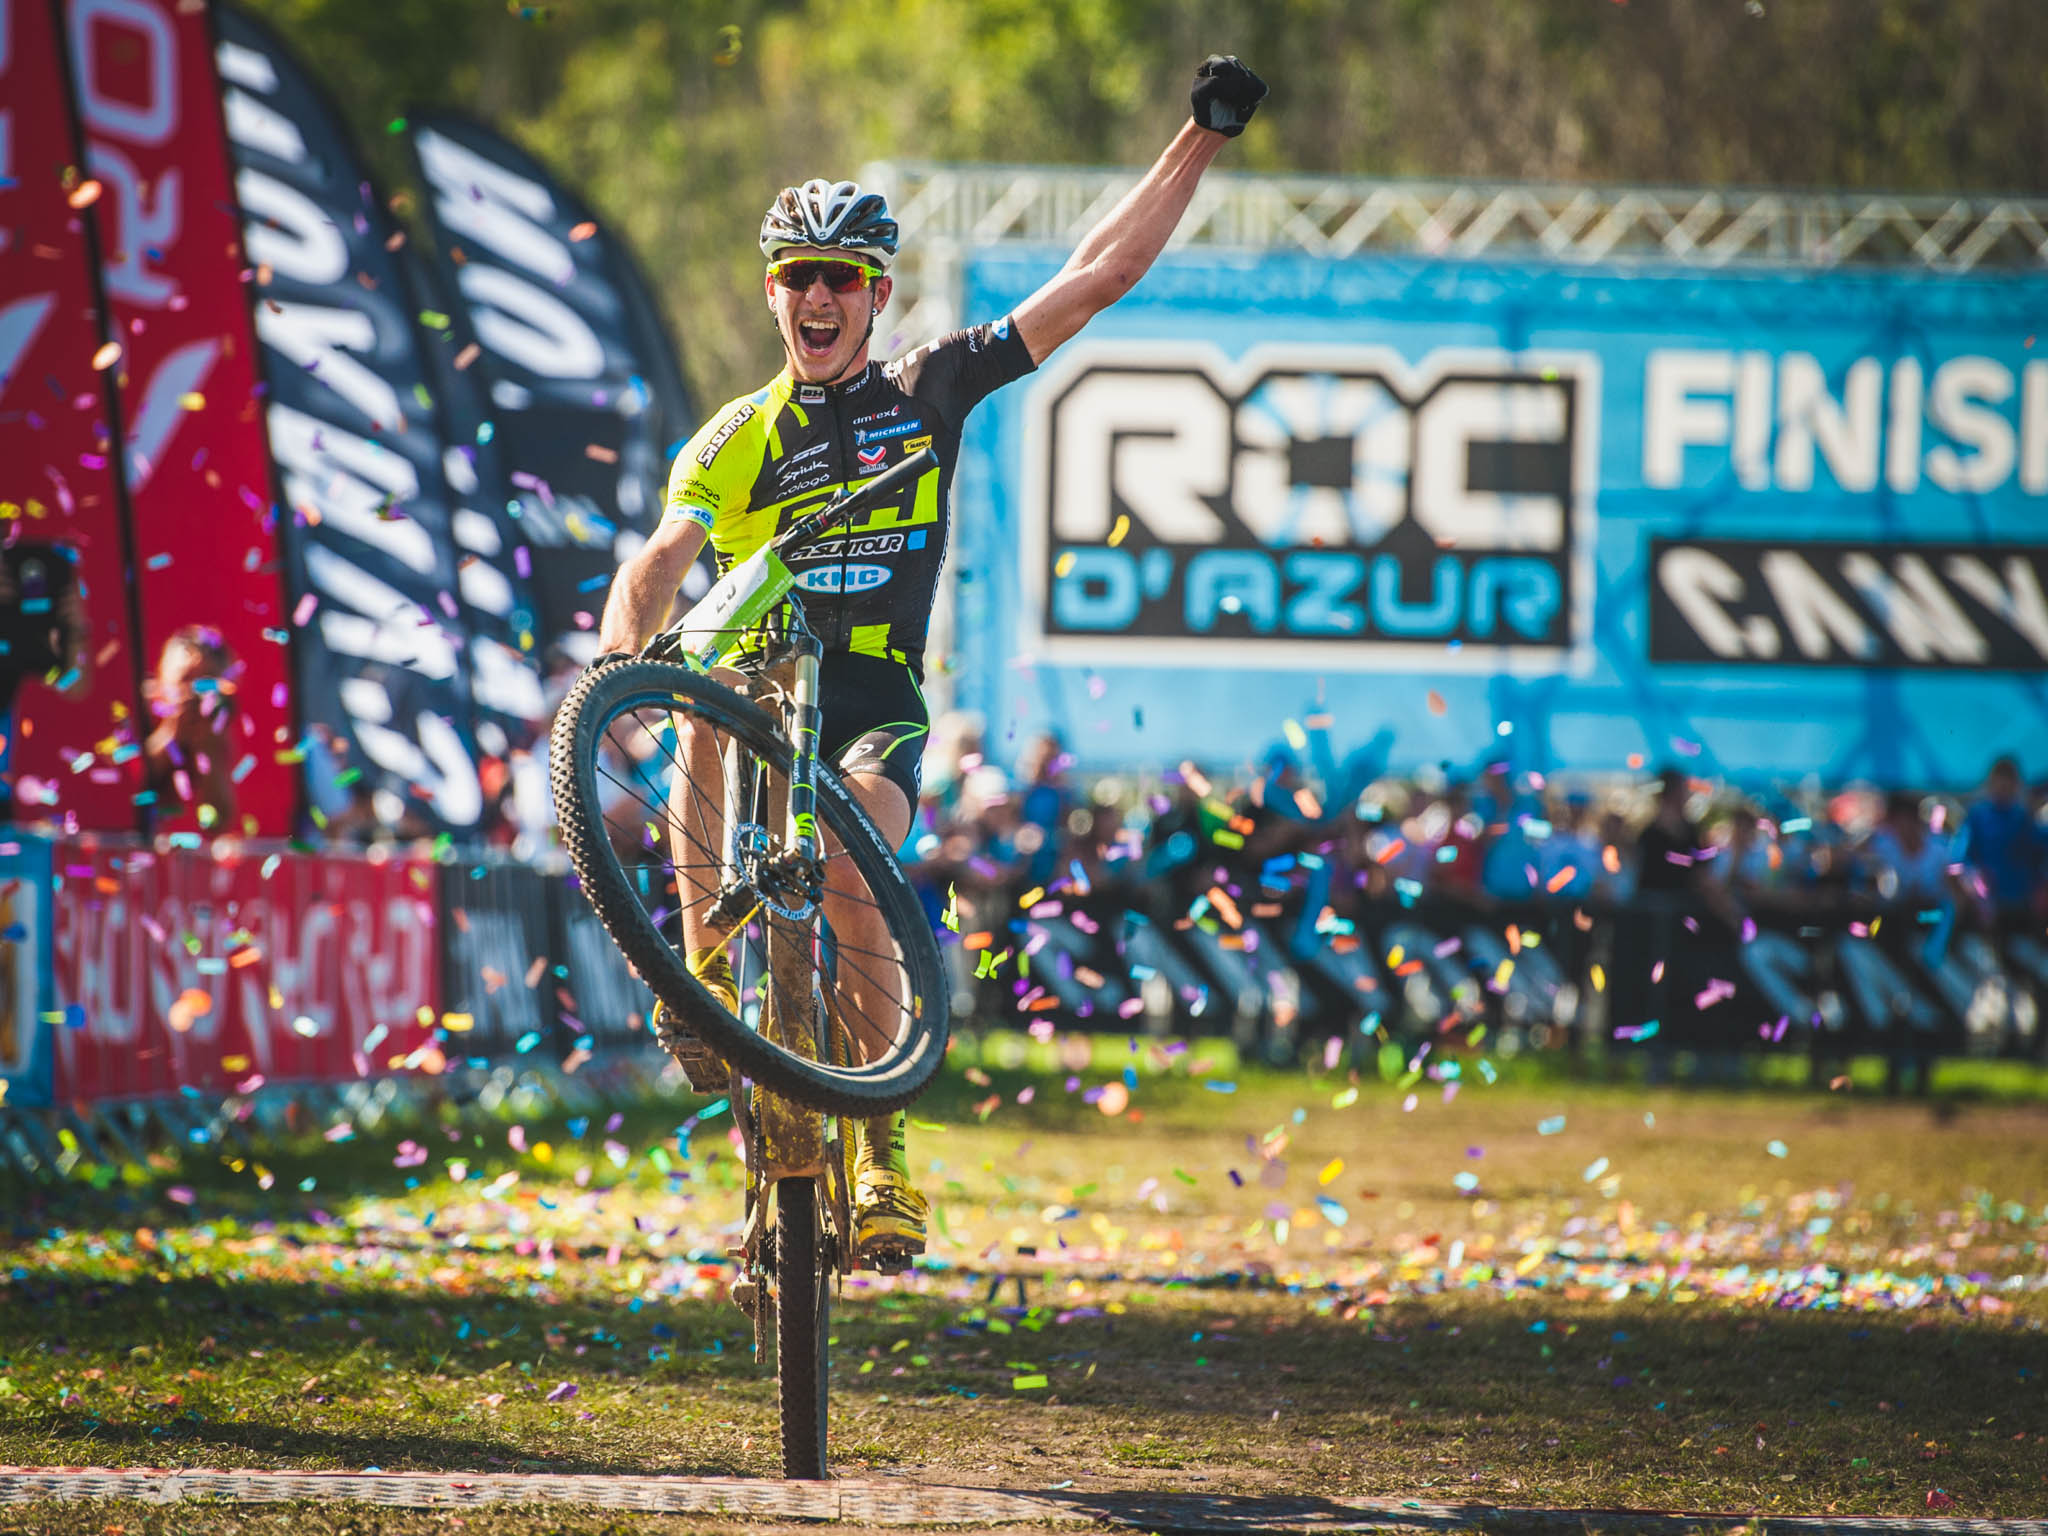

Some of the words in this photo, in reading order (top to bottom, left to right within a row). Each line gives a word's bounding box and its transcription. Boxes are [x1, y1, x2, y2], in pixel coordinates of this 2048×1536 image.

[869, 421, 919, 439] MICHELIN
[1052, 368, 1568, 554] ROC
[808, 569, 880, 587] KMC
[1050, 548, 1564, 641] D'AZUR
